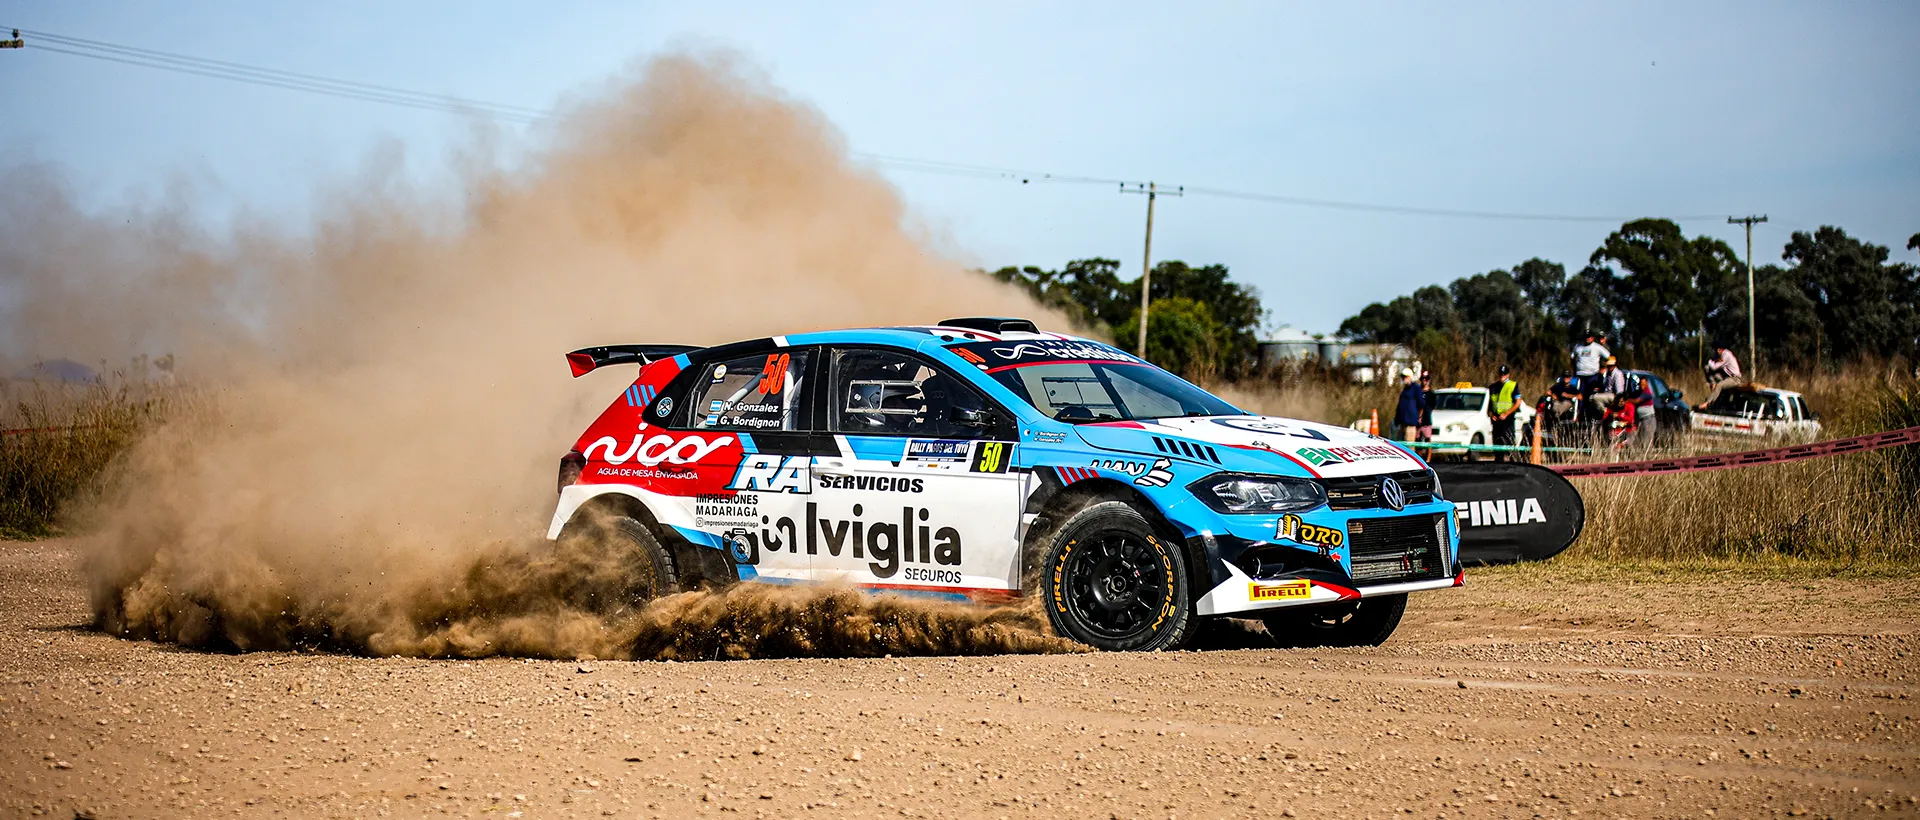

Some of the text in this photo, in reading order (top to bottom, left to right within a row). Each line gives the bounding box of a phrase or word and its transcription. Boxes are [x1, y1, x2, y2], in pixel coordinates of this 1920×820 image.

[758, 353, 790, 395] 50
[724, 401, 779, 413] N. Gonzalez
[720, 416, 780, 428] G. Bordignon
[910, 442, 927, 453] RALLY
[979, 442, 1003, 473] 50
[597, 467, 699, 480] AGUA DE MESA ENVASADA
[723, 452, 812, 495] RA
[819, 474, 924, 494] SERVICIOS
[696, 494, 759, 505] IMPRESIONES
[695, 505, 758, 517] MADARIAGA
[704, 519, 759, 528] impresionesmadariaga
[904, 567, 962, 584] SEGUROS
[1054, 539, 1077, 613] PIRELLI
[1146, 534, 1174, 632] SCORPION
[1253, 583, 1307, 598] PIRELLI
